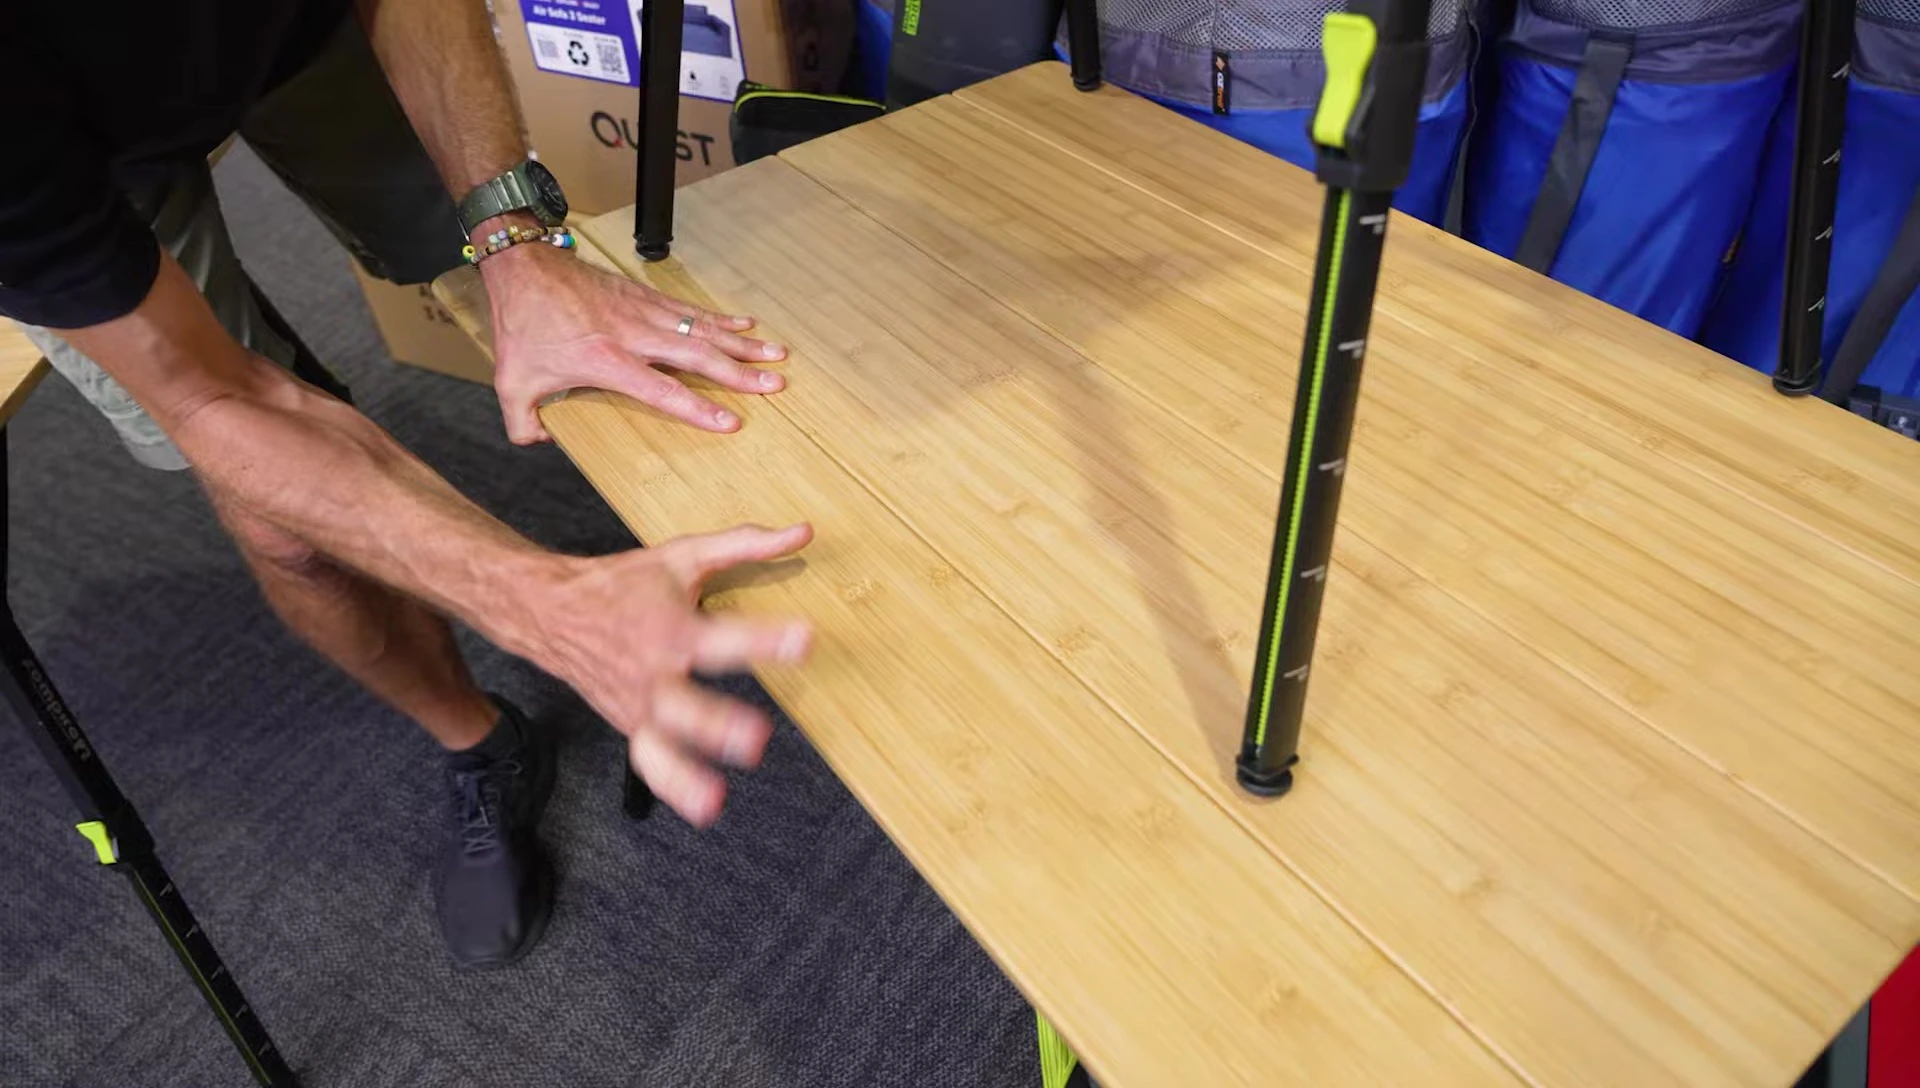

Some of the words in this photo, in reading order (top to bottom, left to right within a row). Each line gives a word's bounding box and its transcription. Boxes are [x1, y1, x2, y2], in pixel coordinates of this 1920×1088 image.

[532, 4, 547, 17] Air
[547, 7, 569, 20] Sofa
[576, 11, 606, 26] Seater
[590, 110, 716, 166] QUST
